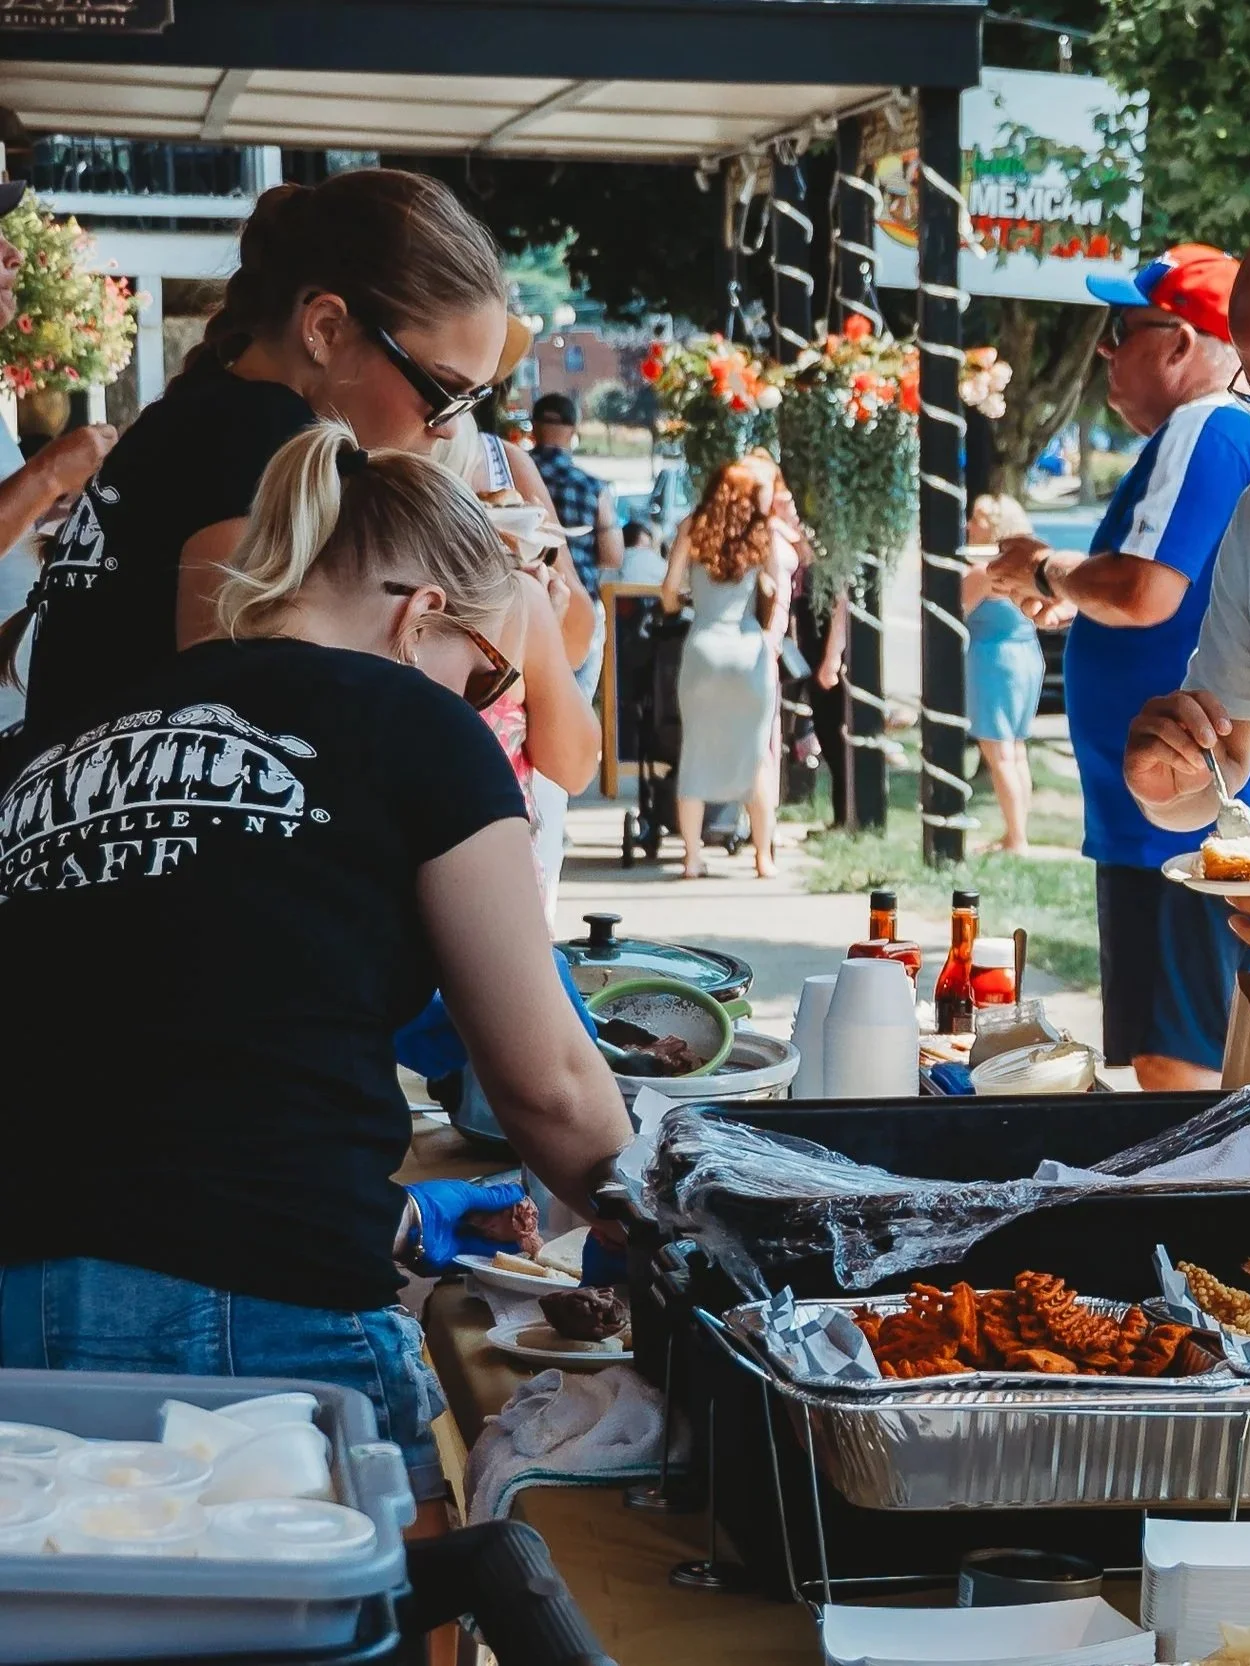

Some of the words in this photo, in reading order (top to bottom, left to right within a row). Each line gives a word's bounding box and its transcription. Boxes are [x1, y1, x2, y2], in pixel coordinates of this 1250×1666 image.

[65, 572, 98, 588] NY
[0, 811, 190, 876] COTTVILLE
[245, 815, 300, 838] NY
[1, 837, 197, 893] TAFF
